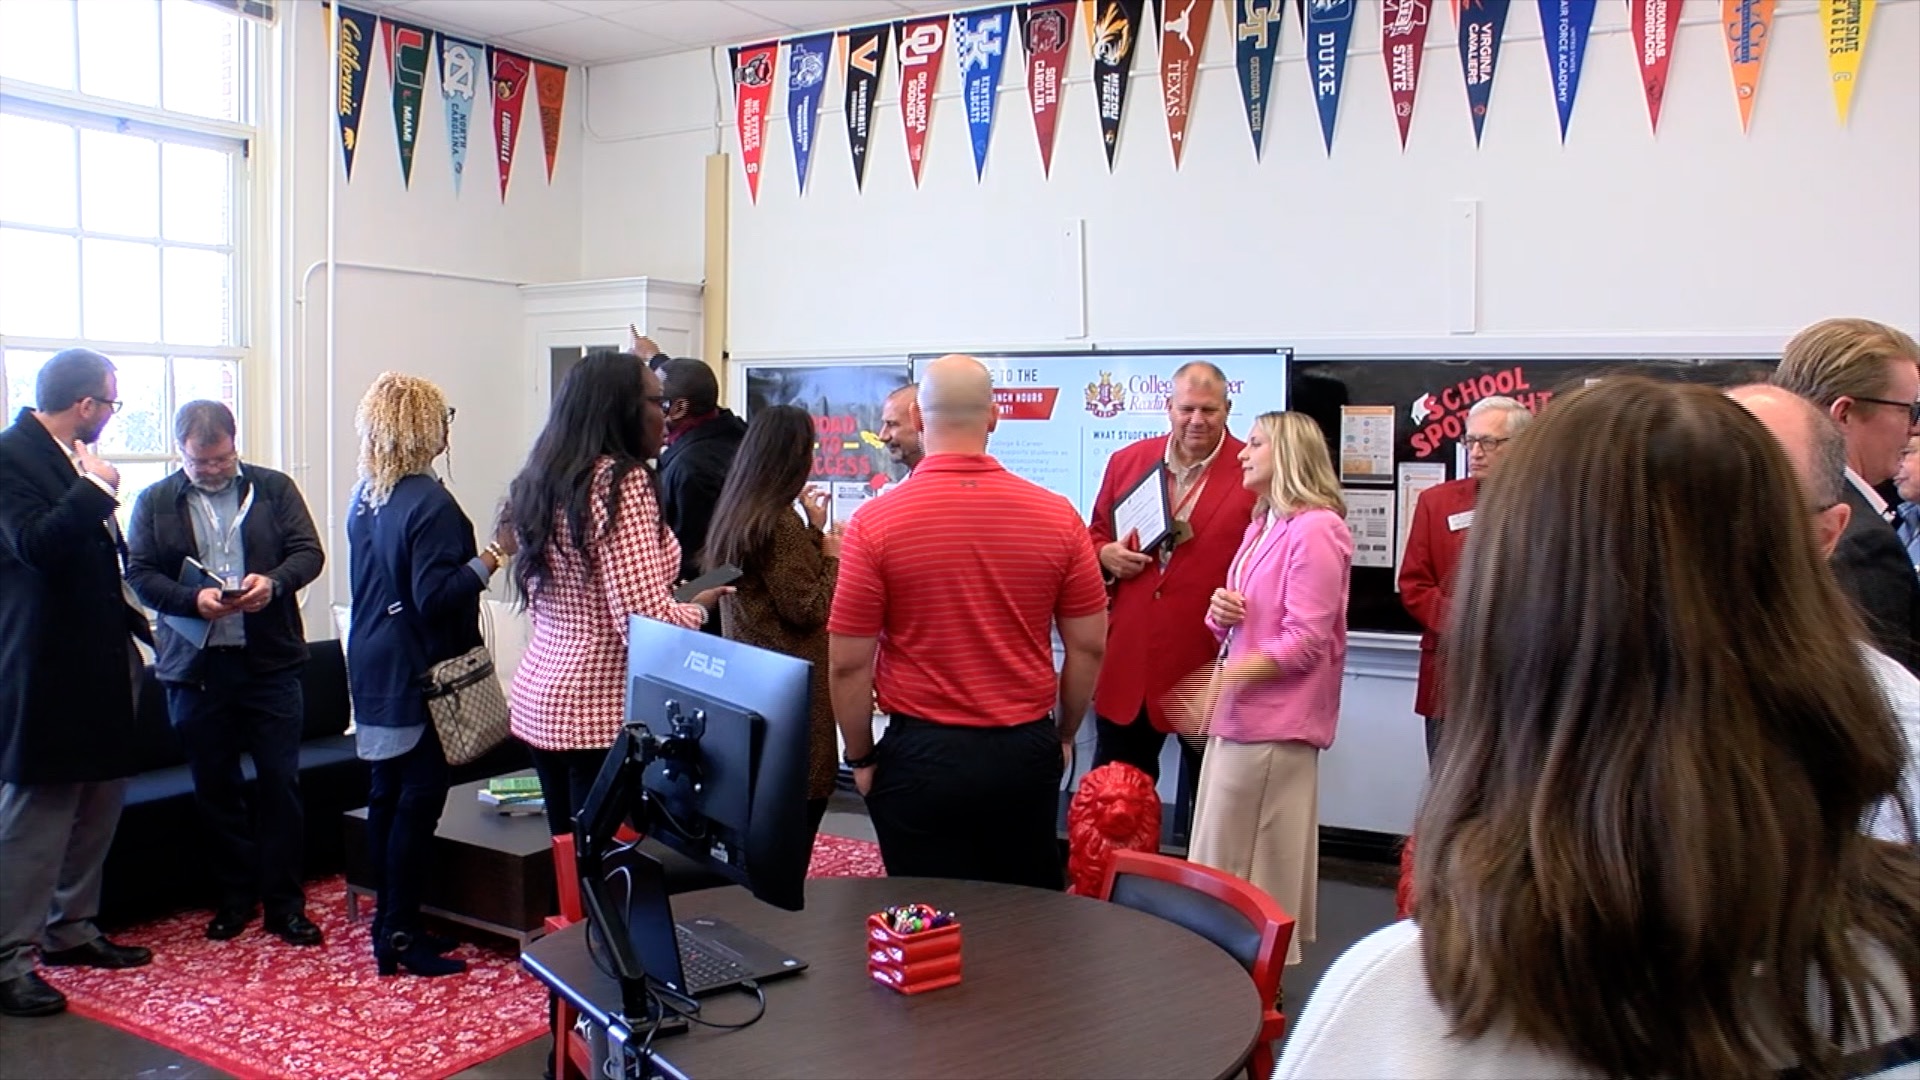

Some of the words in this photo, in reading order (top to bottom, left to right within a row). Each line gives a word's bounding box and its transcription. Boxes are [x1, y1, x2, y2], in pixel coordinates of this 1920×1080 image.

[1560, 0, 1569, 17] AIR
[1656, 0, 1667, 57] RKANSAS
[851, 34, 879, 78] V
[900, 24, 943, 65] OU
[1468, 23, 1478, 85] CAVALIERS
[1479, 22, 1493, 84] VIRGINIA
[1559, 18, 1569, 52] FORCE
[339, 18, 362, 116] California
[396, 28, 424, 89] U
[1250, 56, 1260, 100] GEORGIA
[1318, 32, 1335, 96] DUKE
[1392, 44, 1406, 92] STATE
[1558, 53, 1568, 103] ACADEMY
[752, 99, 760, 114] NC
[857, 79, 868, 137] VANDERBILT
[907, 79, 917, 128] SOONERS
[916, 71, 928, 134] OKLAHOMA
[970, 79, 980, 124] WILDCATS
[981, 76, 990, 124] KENTUCKY
[1034, 60, 1045, 114] CAROLINA
[1046, 67, 1056, 103] SOUTH
[1102, 74, 1111, 119] TIGERS
[1109, 73, 1119, 120] MIZZOU
[1166, 59, 1181, 117] TEXAS
[403, 105, 413, 142] MIAMI
[451, 103, 459, 155] CAROLINA
[501, 111, 511, 163] LOUISVILLE
[743, 98, 752, 152] WOLFPACK
[751, 115, 760, 148] STATE
[1251, 101, 1261, 132] TECH
[746, 162, 759, 174] S
[999, 369, 1013, 381] TO
[1017, 369, 1038, 381] THE
[1016, 392, 1044, 403] HOURS
[1129, 374, 1172, 396] Colleg
[1423, 367, 1530, 420] SCHOOL
[820, 436, 842, 456] TO
[1093, 431, 1115, 439] WHAT
[683, 650, 727, 679] ASUS
